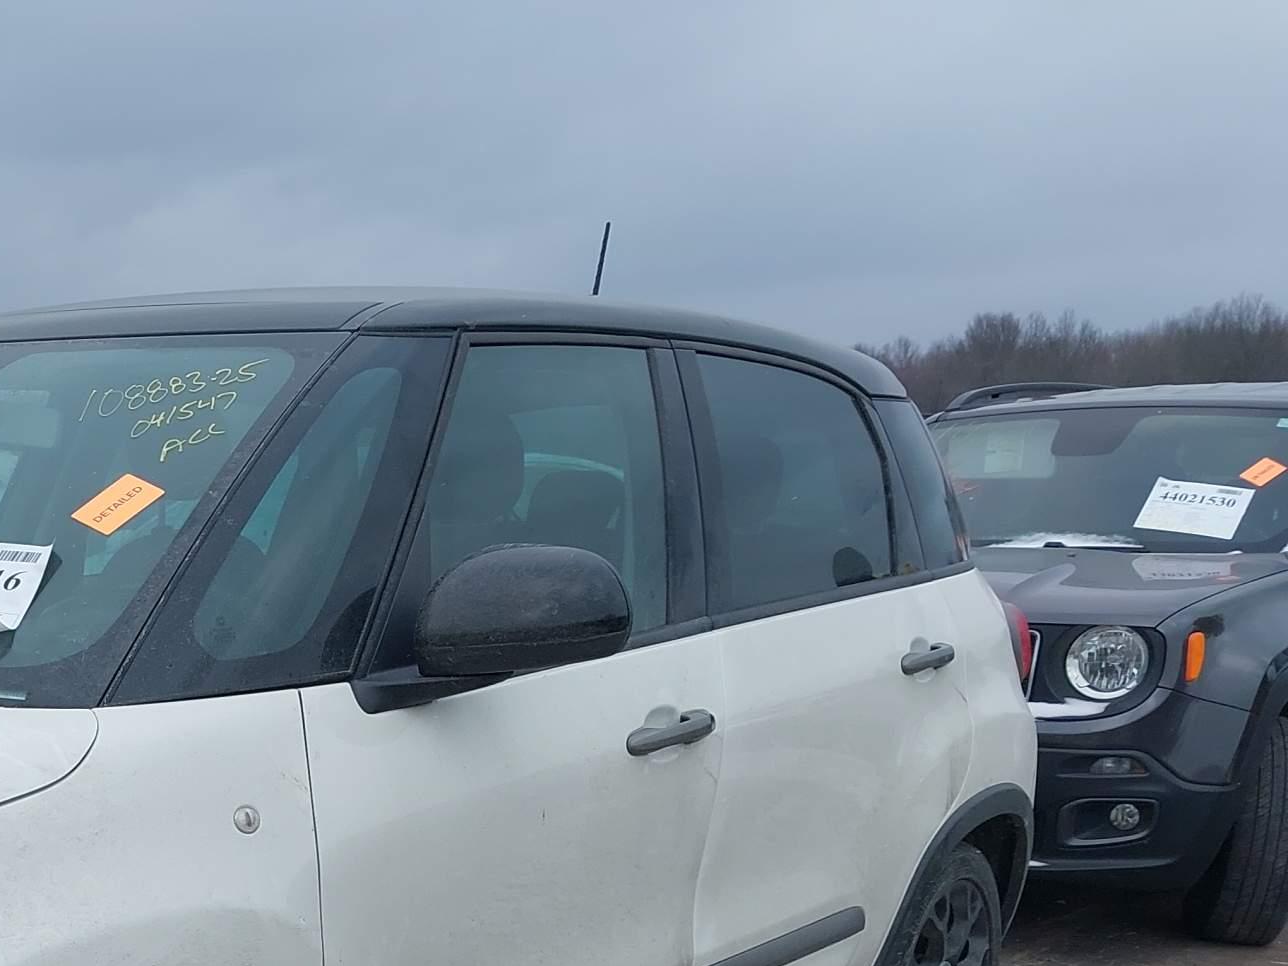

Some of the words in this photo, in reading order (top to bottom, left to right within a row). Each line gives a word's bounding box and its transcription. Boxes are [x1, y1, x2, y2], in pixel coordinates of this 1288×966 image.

[78, 358, 271, 422] 108883-25
[159, 423, 225, 462] ACC
[93, 485, 143, 524] DETAILED
[1160, 491, 1236, 508] 44021530
